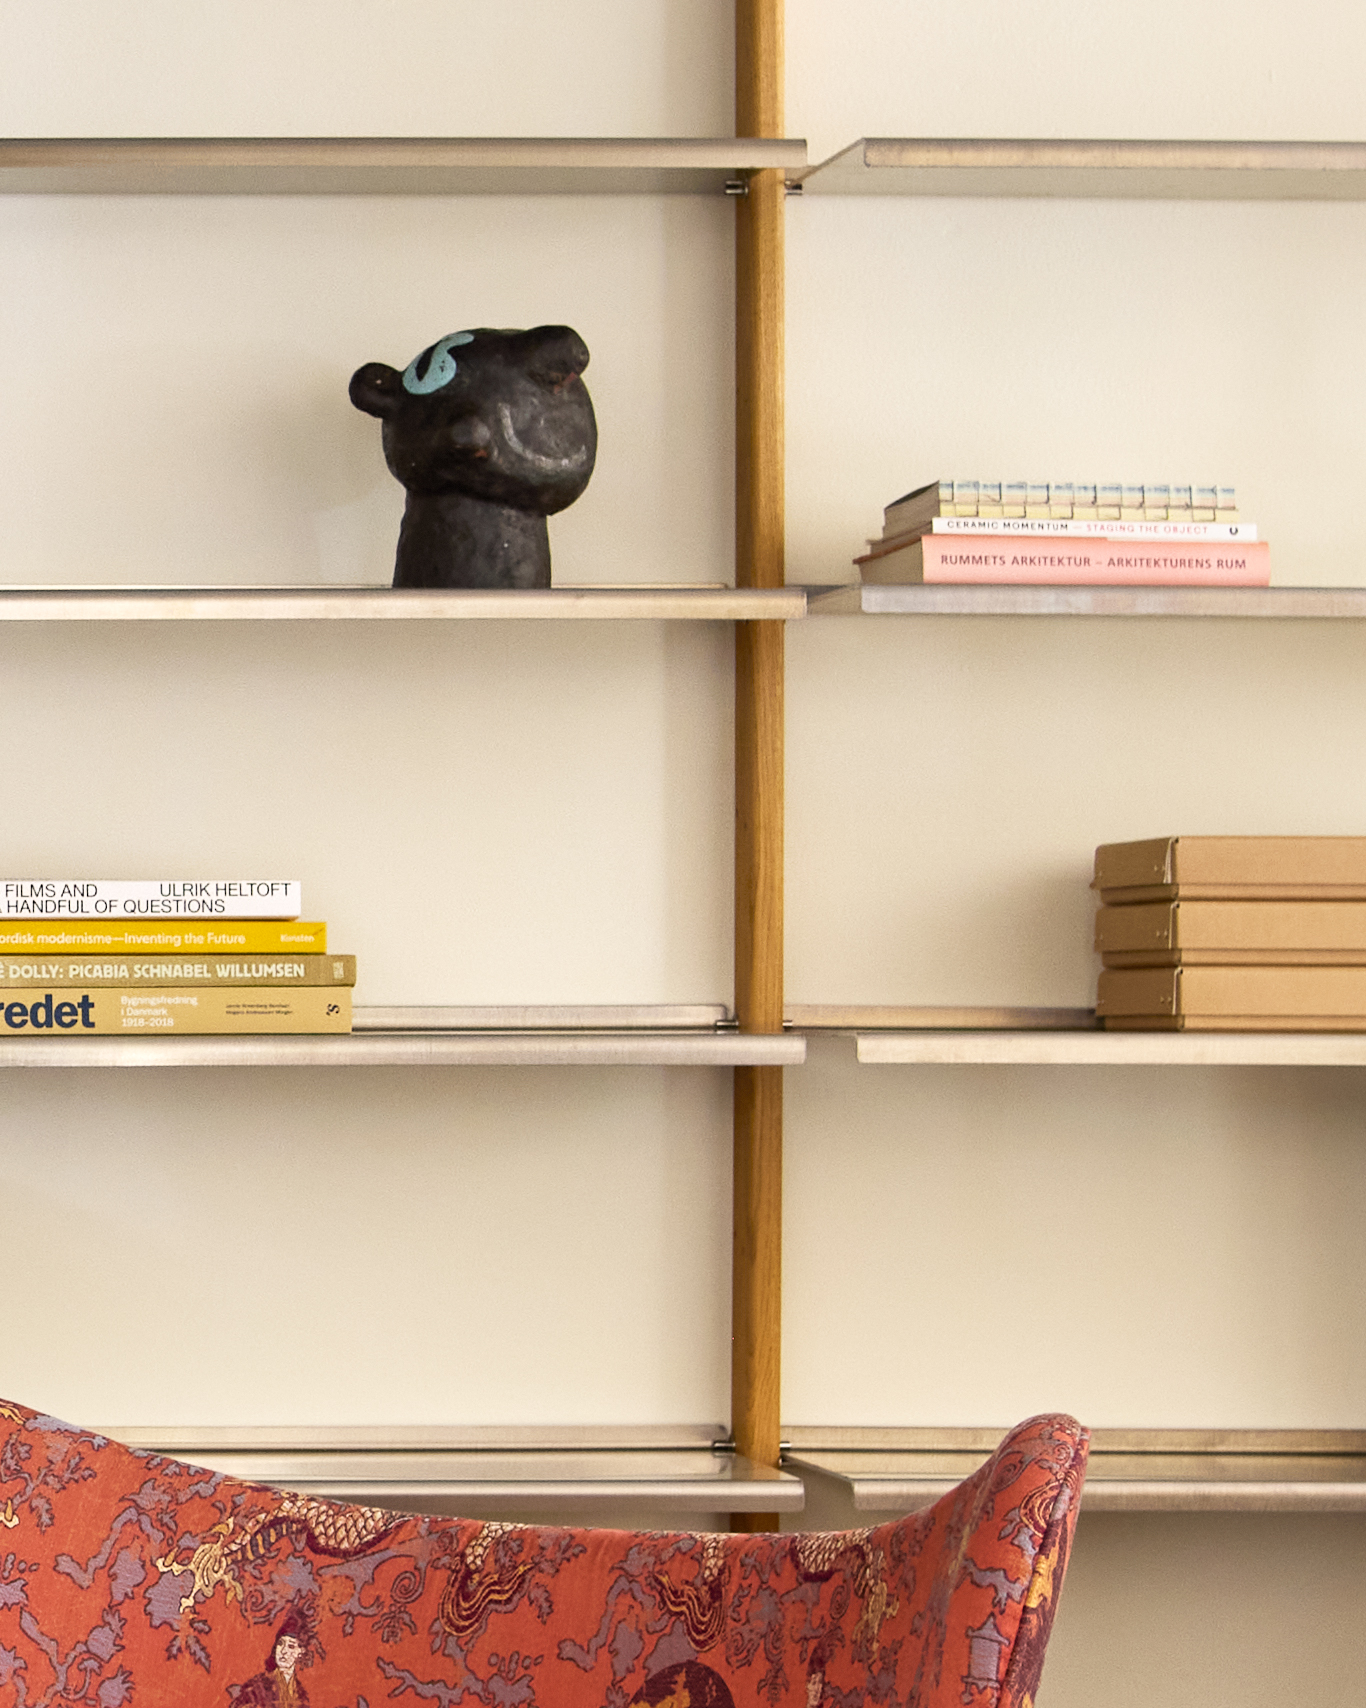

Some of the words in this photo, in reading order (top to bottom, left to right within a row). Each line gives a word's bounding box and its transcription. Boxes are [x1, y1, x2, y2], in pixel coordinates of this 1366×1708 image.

[947, 521, 999, 530] CERAMIC
[1003, 522, 1068, 531] MOMENTUM
[1087, 524, 1135, 533] STAGING
[1139, 525, 1160, 534] THE
[1163, 526, 1208, 535] OBJECT
[941, 555, 1006, 566] RUMMETS
[1011, 556, 1091, 567] ARKITEKTUR
[1107, 557, 1212, 569] ARKITEKTURENS
[1217, 559, 1247, 569] RUM
[5, 884, 56, 897] FILMS
[61, 884, 98, 897] AND
[160, 883, 211, 897] ULRIK
[215, 883, 291, 897] HELTOFT
[7, 900, 89, 913] HANDFUL
[95, 900, 119, 913] OF
[123, 899, 225, 914] QUESTIONS
[184, 932, 204, 944] the
[207, 932, 246, 944] Future
[9, 964, 64, 978] DOLLY:
[69, 964, 129, 978] PICABIA
[133, 964, 212, 978] SCHNABEL
[216, 963, 305, 978] WILLUMSEN
[0, 993, 95, 1028] edet
[126, 1007, 168, 1016] Danmark
